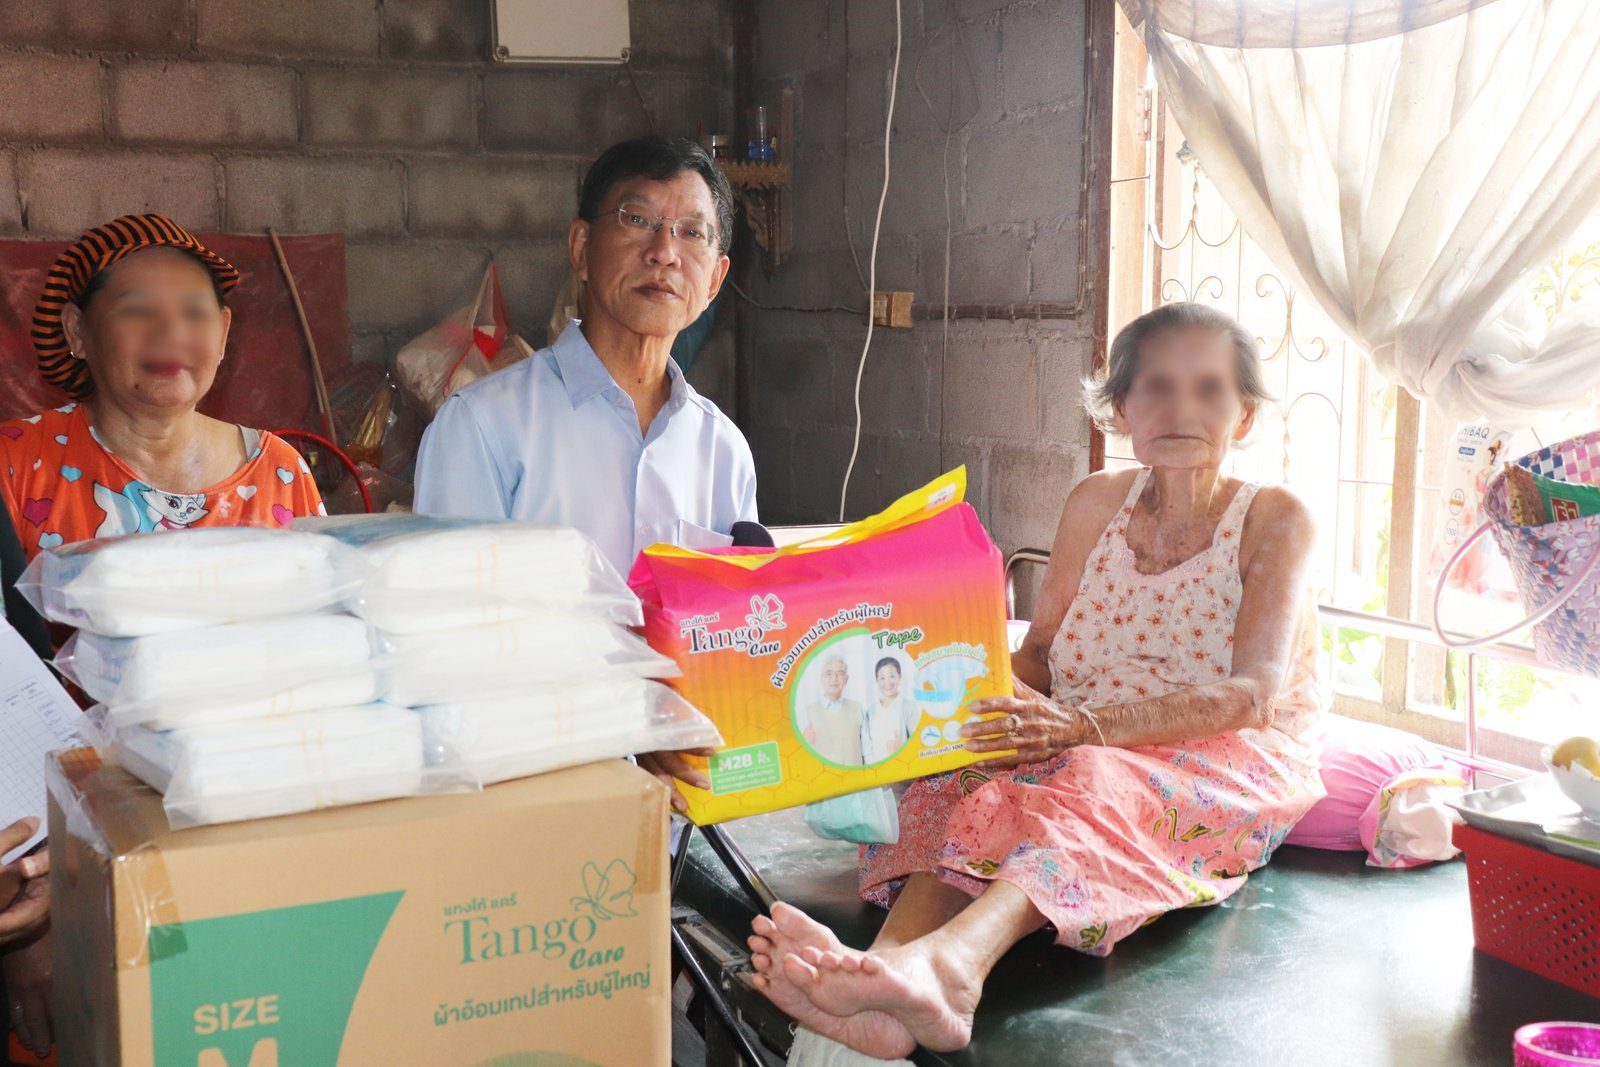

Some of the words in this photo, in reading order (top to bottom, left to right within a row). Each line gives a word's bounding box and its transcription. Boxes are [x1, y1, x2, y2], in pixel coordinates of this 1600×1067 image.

[682, 625, 764, 653] Tango
[749, 642, 780, 656] Care
[771, 604, 891, 688] ผ้าอ้อมเทปสำหรับผู้ใหญ่
[872, 628, 922, 649] Tape
[718, 753, 753, 773] M28
[443, 897, 487, 916] แทงโก้
[490, 892, 517, 908] แคร์
[443, 914, 597, 965] Tango
[569, 946, 625, 970] Care
[433, 963, 651, 1026] ผ้าอ้อมเทปสำหรับผู้ใหญ่
[193, 994, 279, 1035] SIZE
